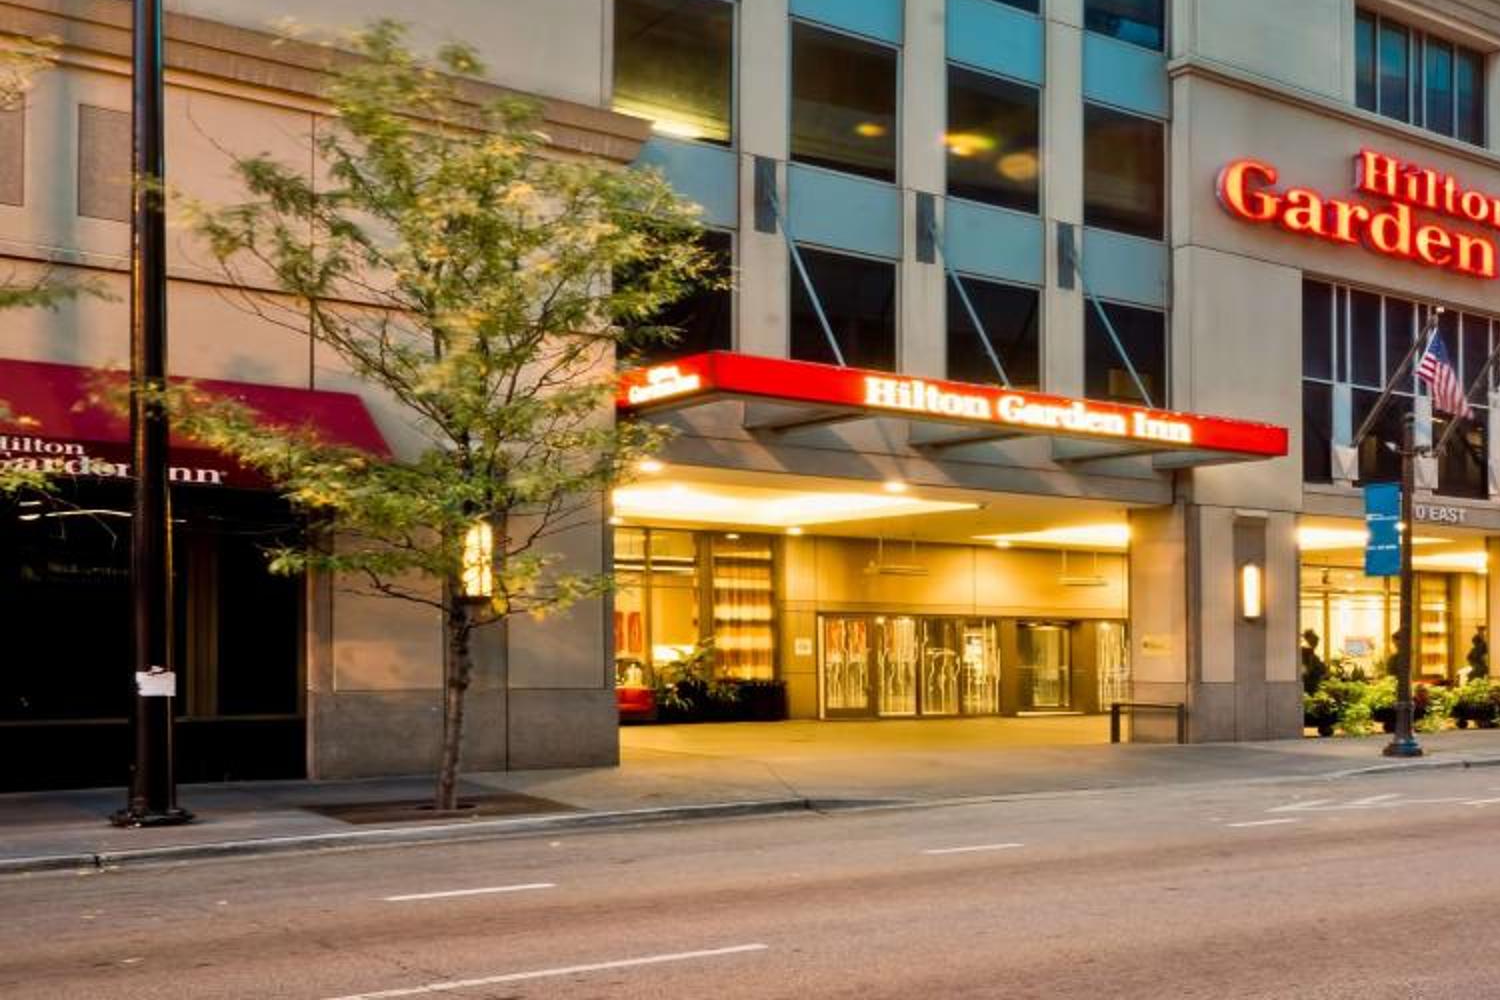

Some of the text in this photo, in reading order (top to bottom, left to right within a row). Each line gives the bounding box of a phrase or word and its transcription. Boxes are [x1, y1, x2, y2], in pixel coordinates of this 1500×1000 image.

[1217, 158, 1498, 279] Garden
[864, 376, 1192, 443] Hilton Garden Inn
[1430, 505, 1467, 522] EAST
